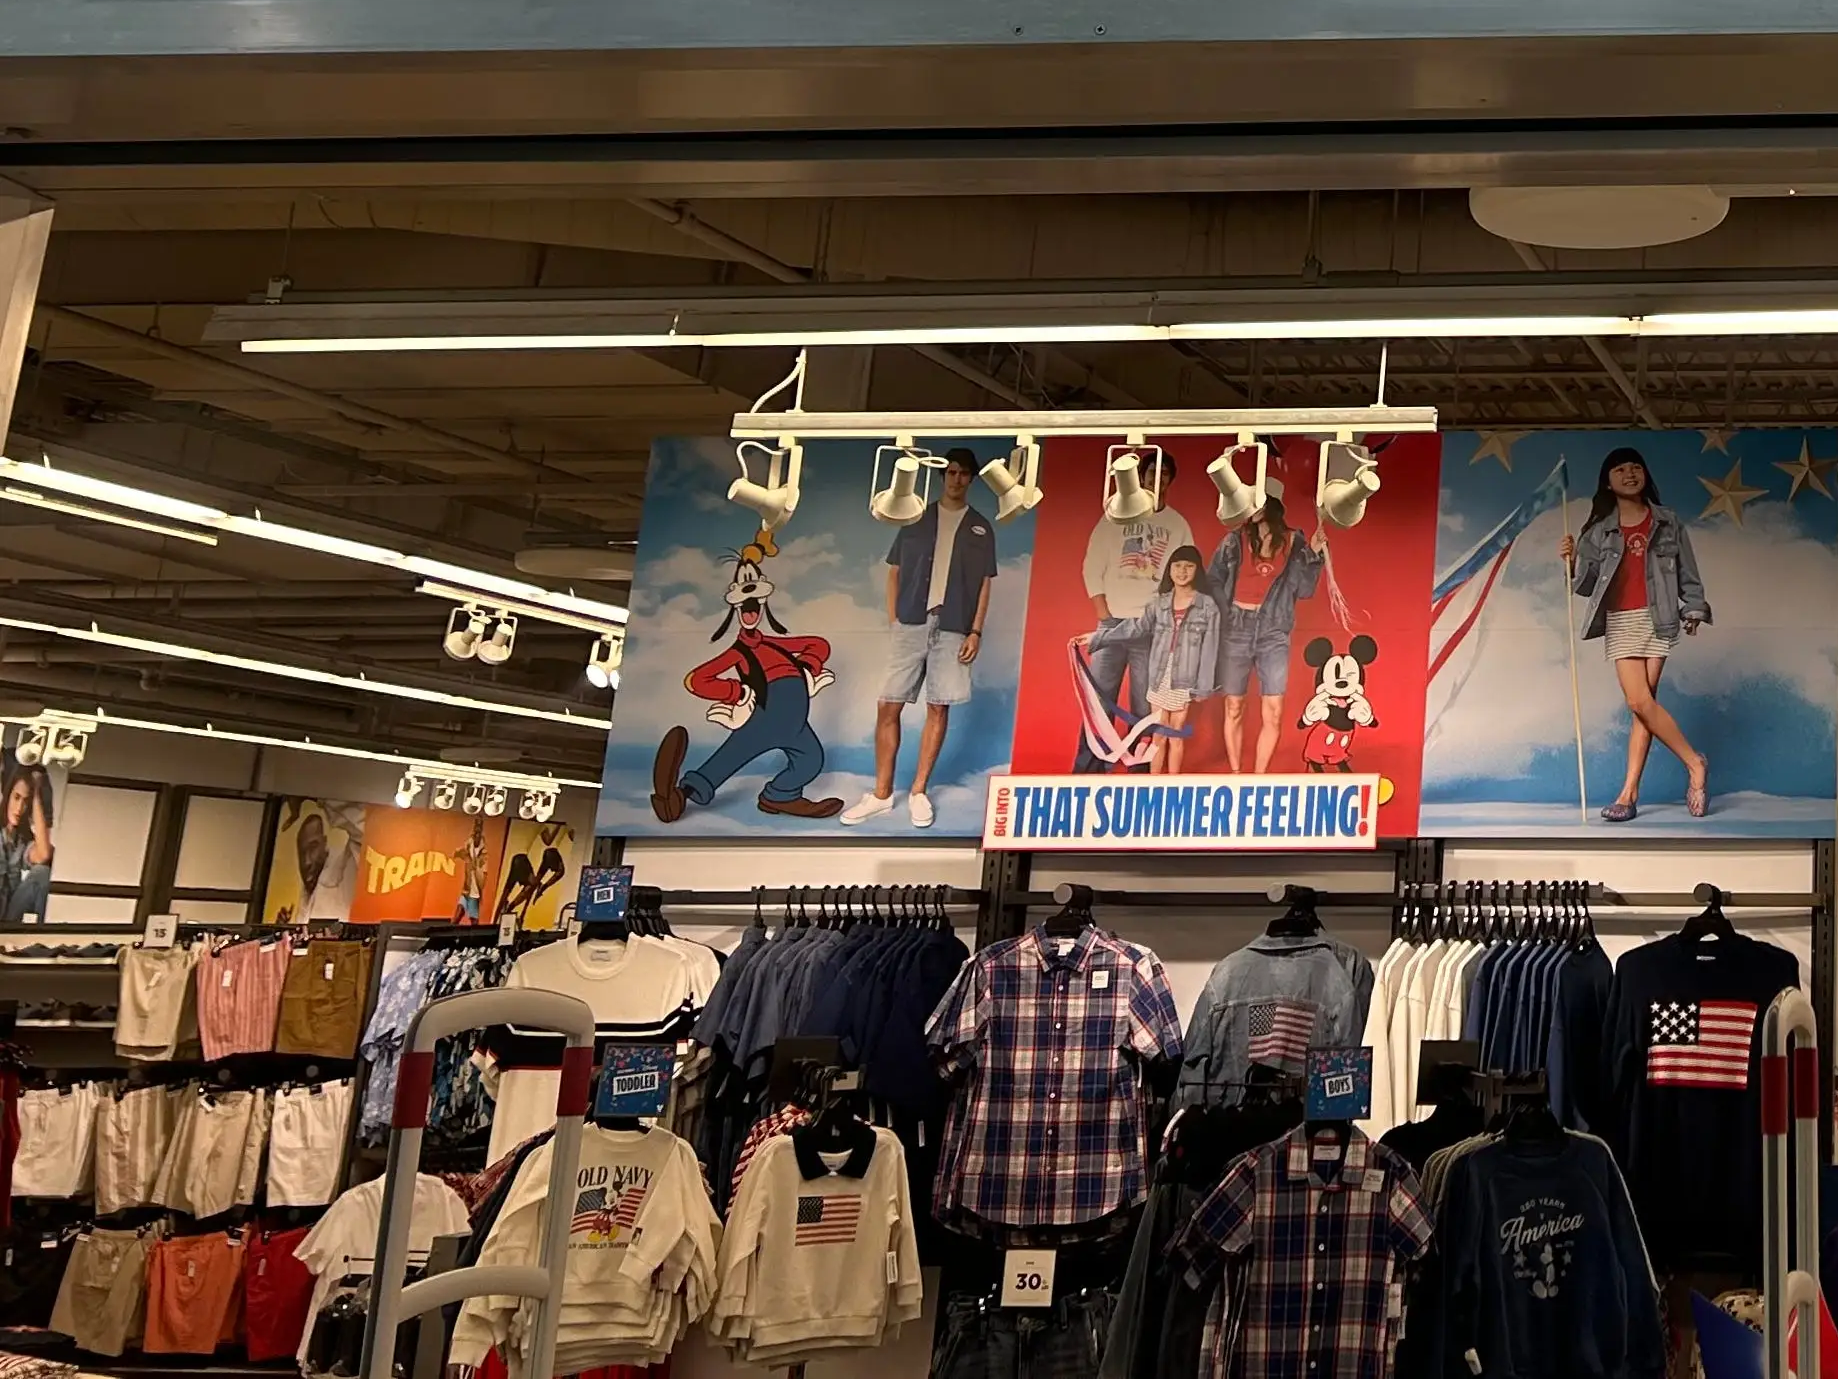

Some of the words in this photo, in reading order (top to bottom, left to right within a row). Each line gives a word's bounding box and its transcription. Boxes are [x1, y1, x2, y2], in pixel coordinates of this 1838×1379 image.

[996, 787, 1011, 815] INTO
[1013, 786, 1091, 838] THAT
[1091, 785, 1233, 838] SUMMER
[1235, 784, 1372, 837] FEELING!
[993, 816, 1008, 838] BIG
[366, 845, 456, 894] TRAIN
[616, 1073, 656, 1093] TODDLER
[1328, 1077, 1351, 1095] BOYS
[577, 1165, 609, 1189] OLD
[613, 1164, 655, 1189] NAVY
[1499, 1212, 1585, 1255] America
[1015, 1273, 1042, 1290] 30
